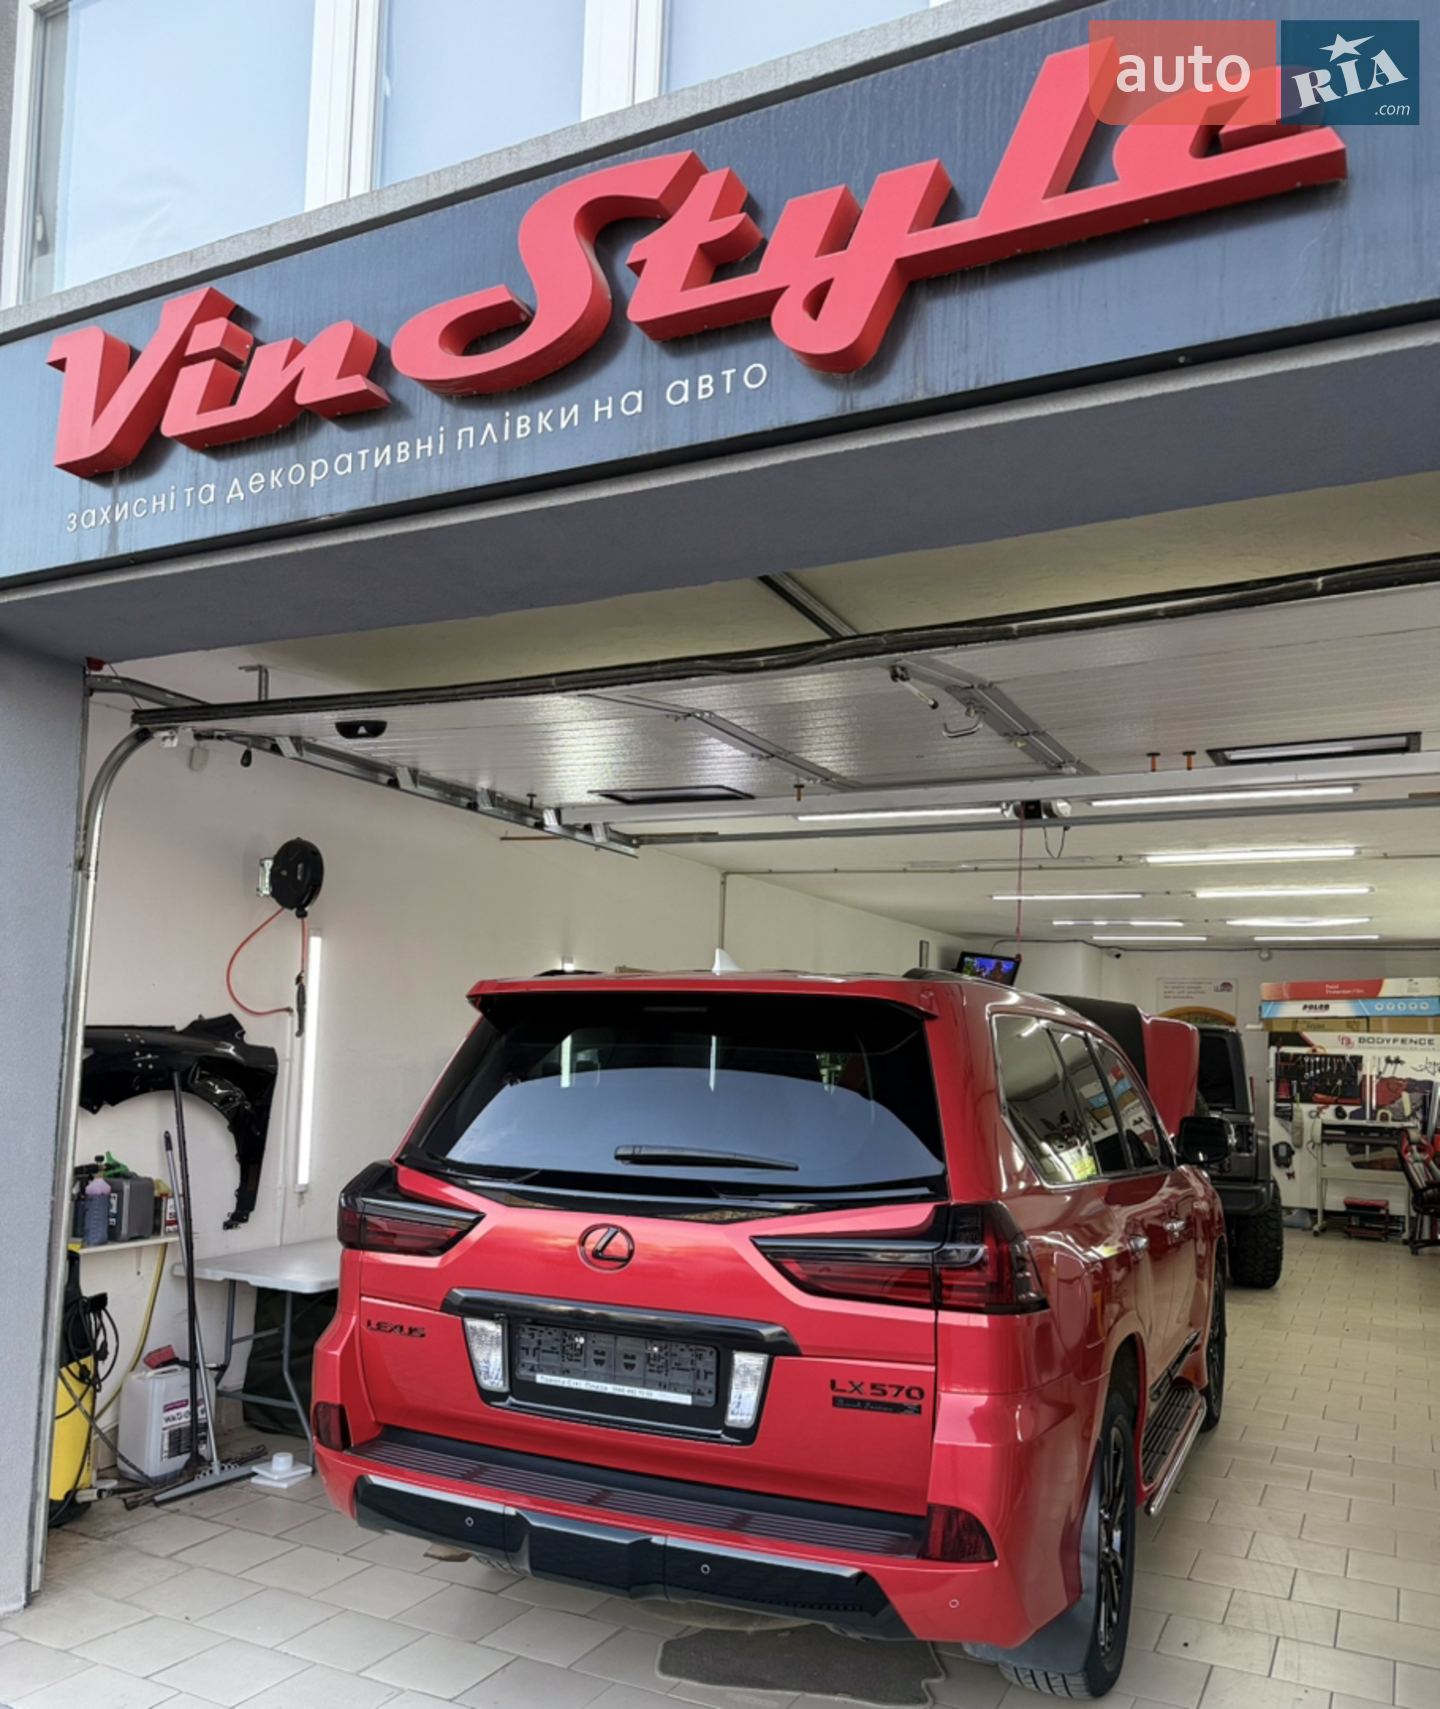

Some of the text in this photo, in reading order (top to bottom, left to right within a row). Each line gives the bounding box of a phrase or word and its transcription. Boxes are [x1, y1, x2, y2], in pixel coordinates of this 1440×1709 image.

[66, 363, 768, 537] захисні та декоративні плівки на авто
[1358, 1036, 1436, 1046] BODYFENCE
[366, 1319, 427, 1338] LEXUS
[830, 1378, 925, 1401] LX 570
